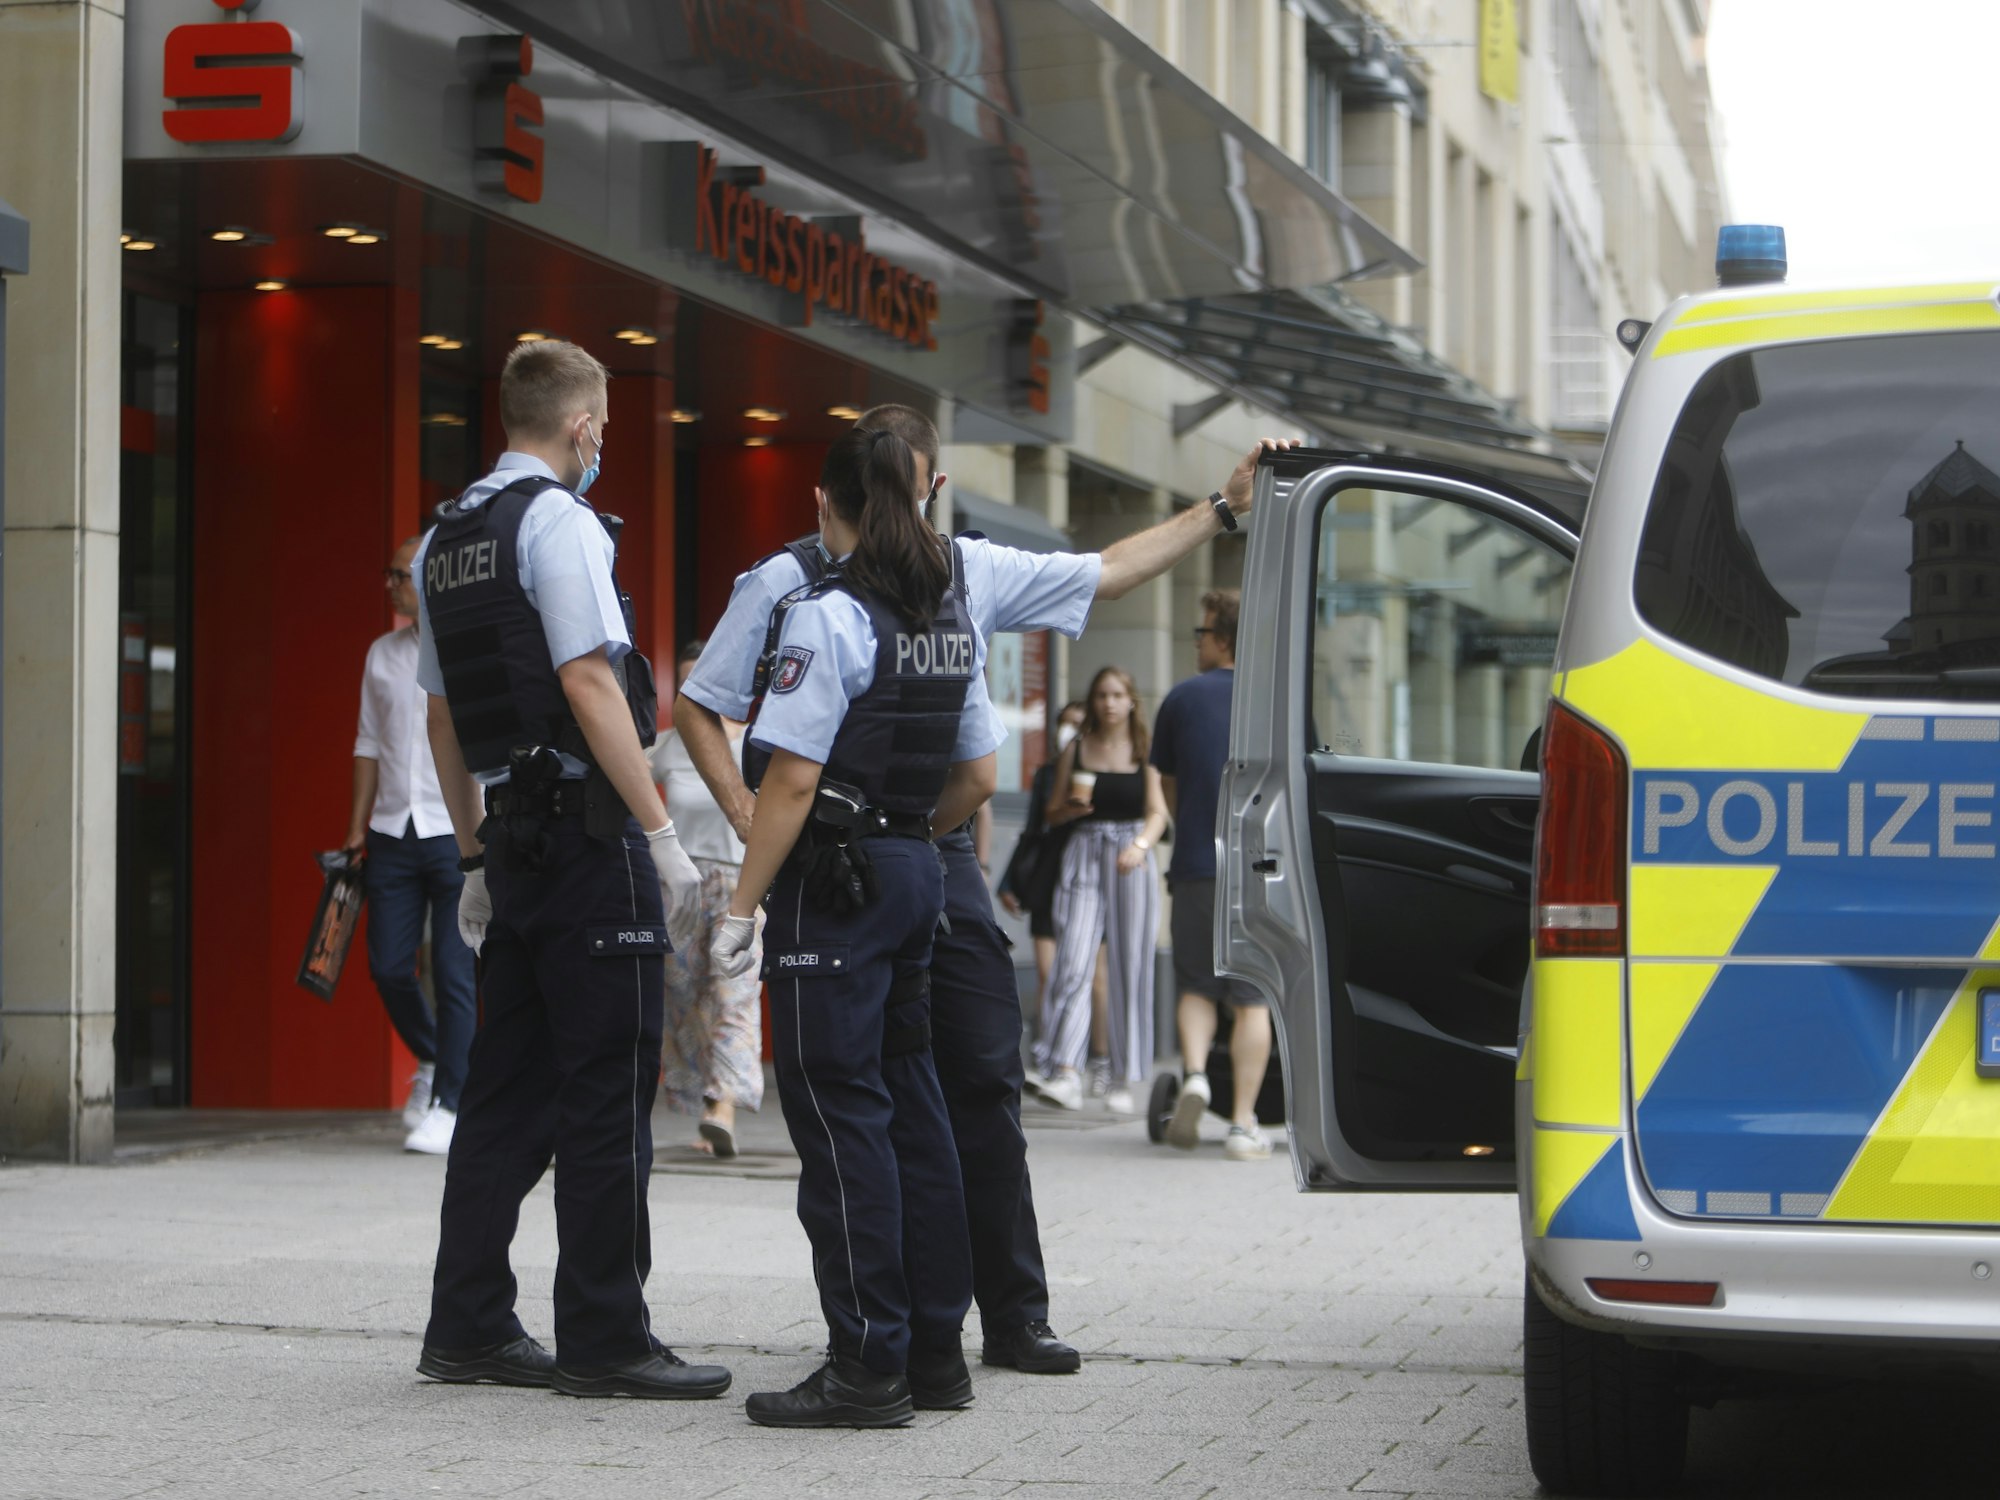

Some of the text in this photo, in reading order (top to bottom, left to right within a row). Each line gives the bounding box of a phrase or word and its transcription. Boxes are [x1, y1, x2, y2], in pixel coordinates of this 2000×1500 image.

[696, 140, 939, 351] Kreissparkasse
[427, 540, 498, 597] POLIZEI
[896, 633, 974, 675] POLIZEI
[1643, 780, 1996, 858] POLIZE
[618, 931, 655, 943] POLIZEI
[780, 954, 819, 967] POLIZEI
